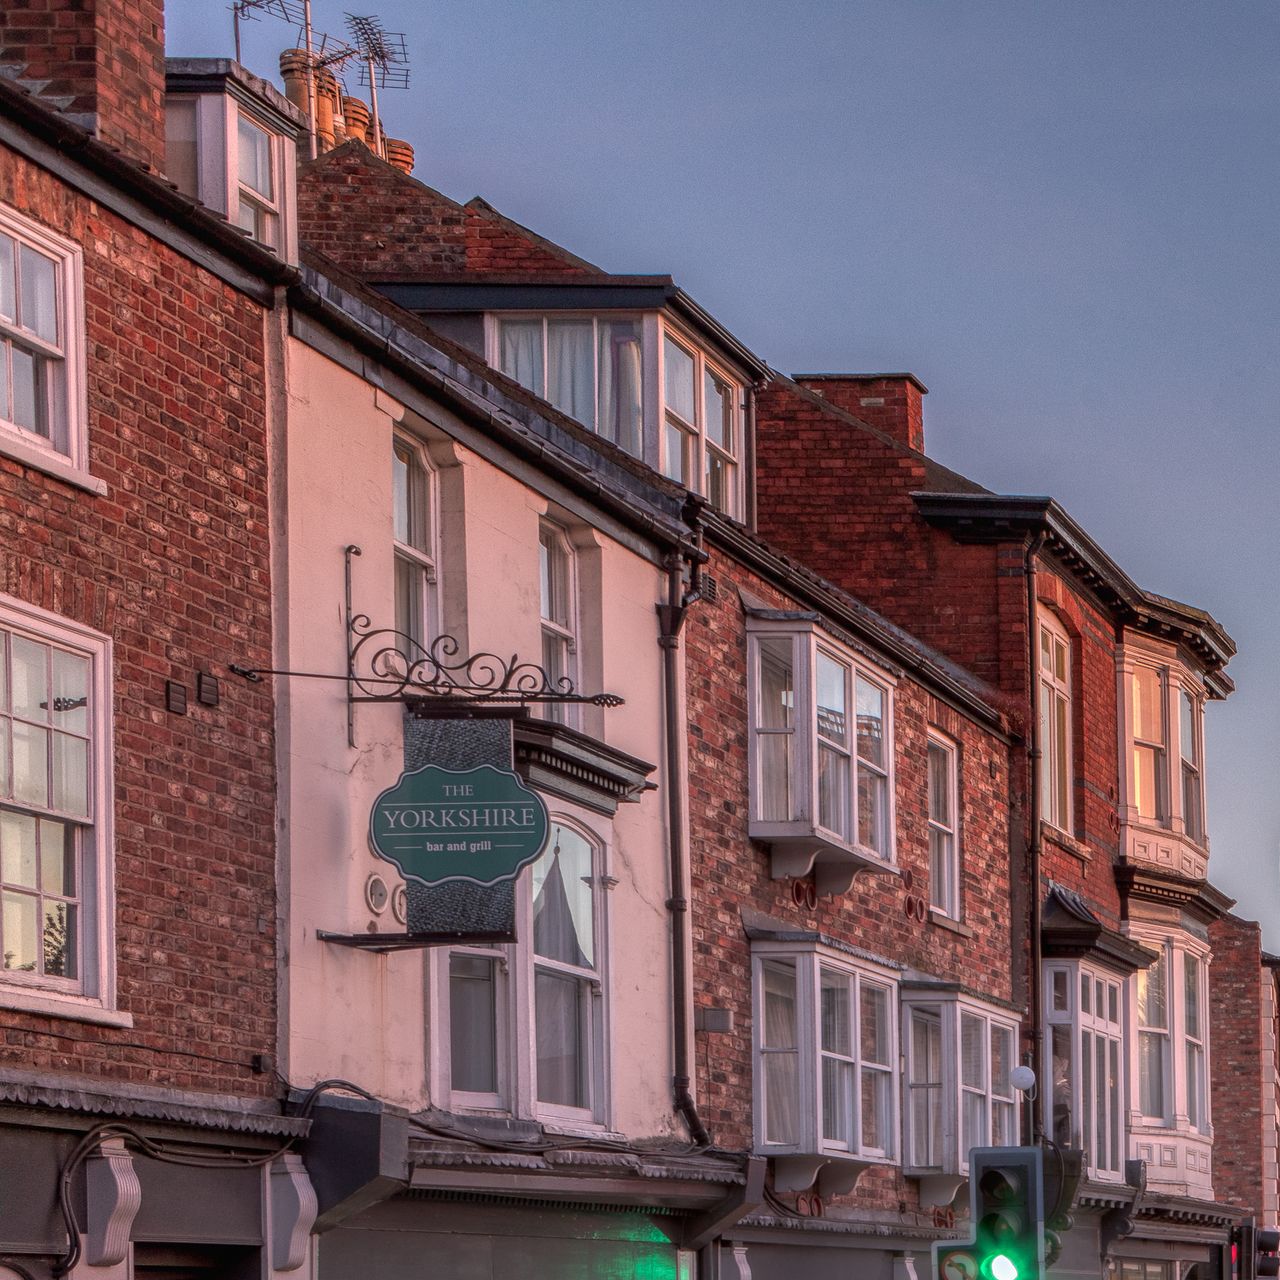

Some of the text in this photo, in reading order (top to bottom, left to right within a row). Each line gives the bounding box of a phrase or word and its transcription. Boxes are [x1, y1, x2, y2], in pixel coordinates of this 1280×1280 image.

[442, 784, 474, 797] THE
[384, 808, 536, 829] YORKSHIRE
[426, 840, 492, 853] bar and grill
